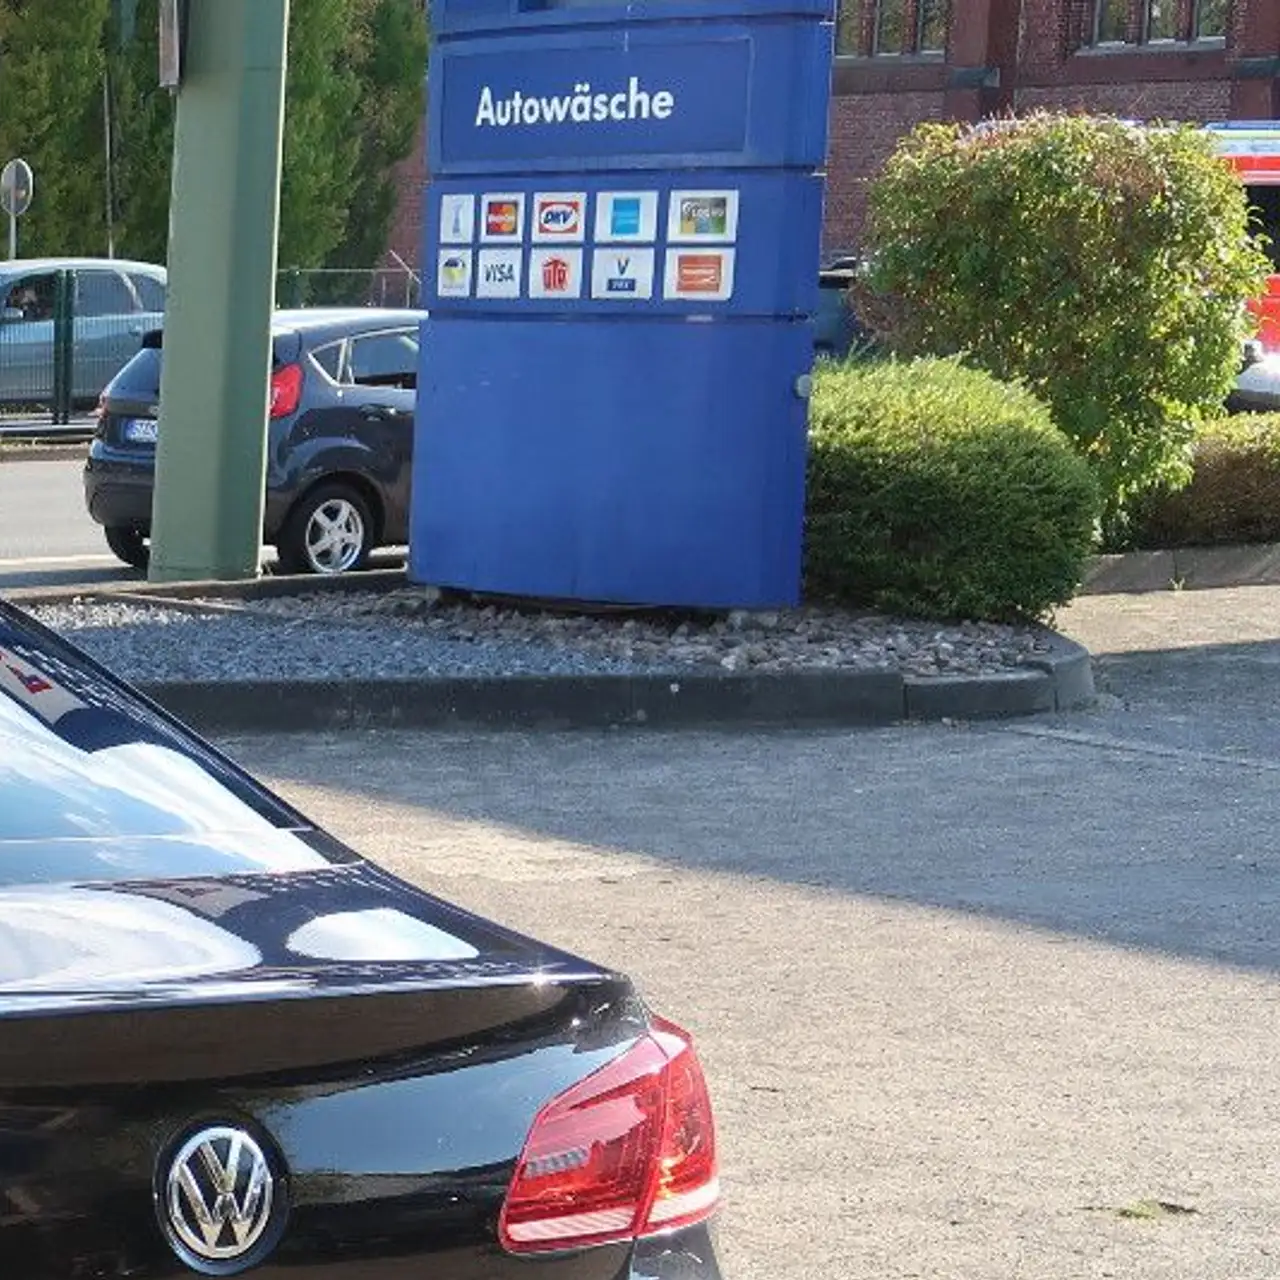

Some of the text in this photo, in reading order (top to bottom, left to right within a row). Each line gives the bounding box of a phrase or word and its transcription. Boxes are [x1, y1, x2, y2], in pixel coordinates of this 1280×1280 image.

[474, 76, 675, 126] Autowäsche
[542, 209, 574, 225] DKV
[485, 263, 515, 282] VISA
